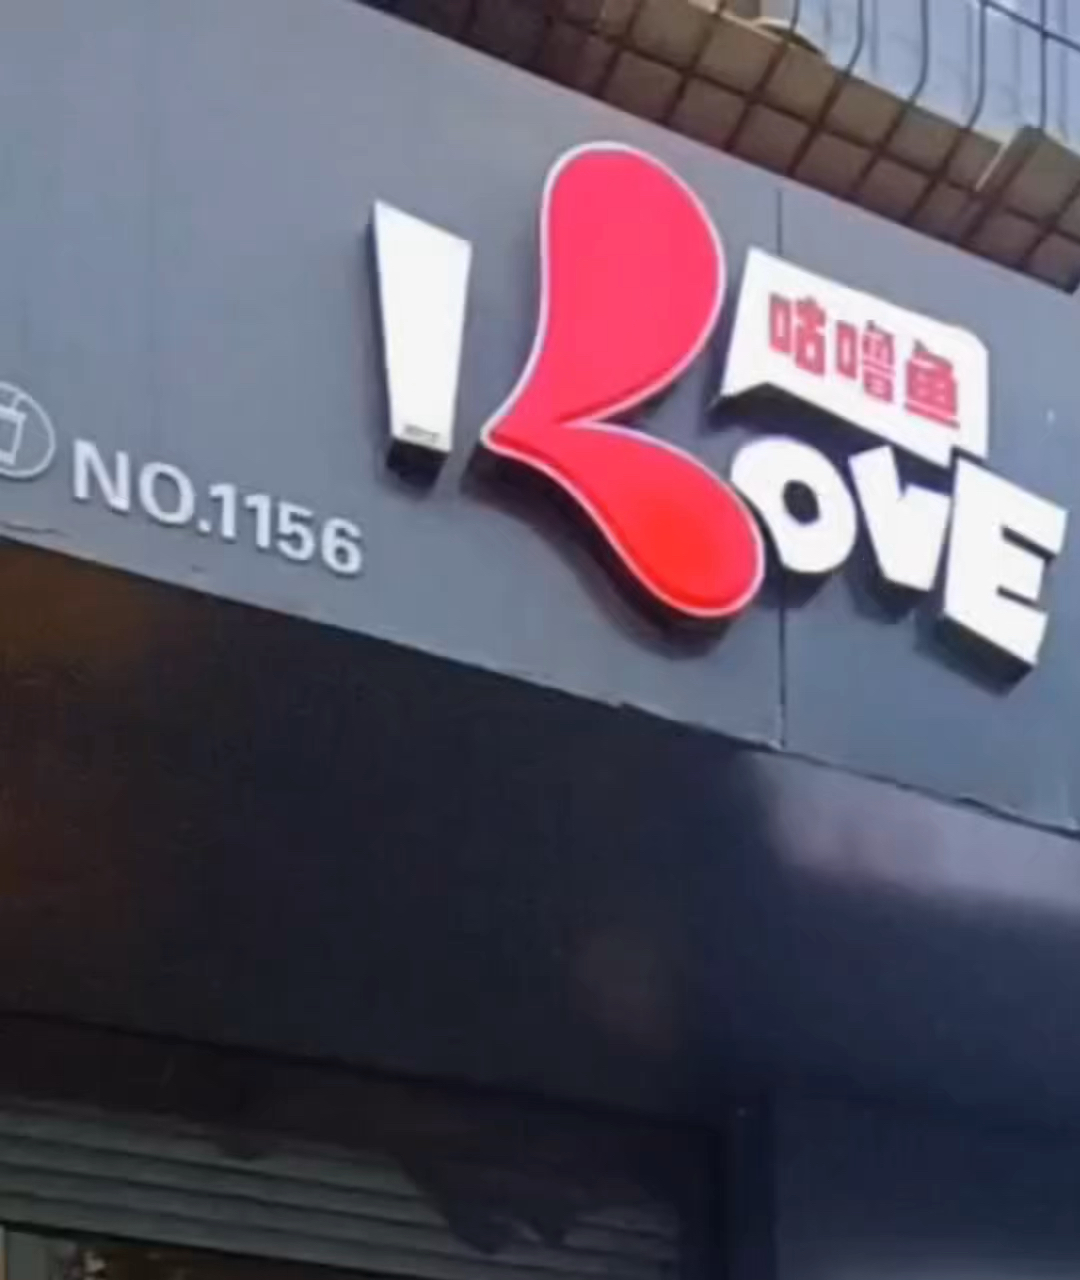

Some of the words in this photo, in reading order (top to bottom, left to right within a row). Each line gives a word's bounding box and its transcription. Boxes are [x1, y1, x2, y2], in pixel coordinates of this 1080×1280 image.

[768, 292, 960, 428] 咕噜鱼
[73, 440, 363, 576] NO.1156
